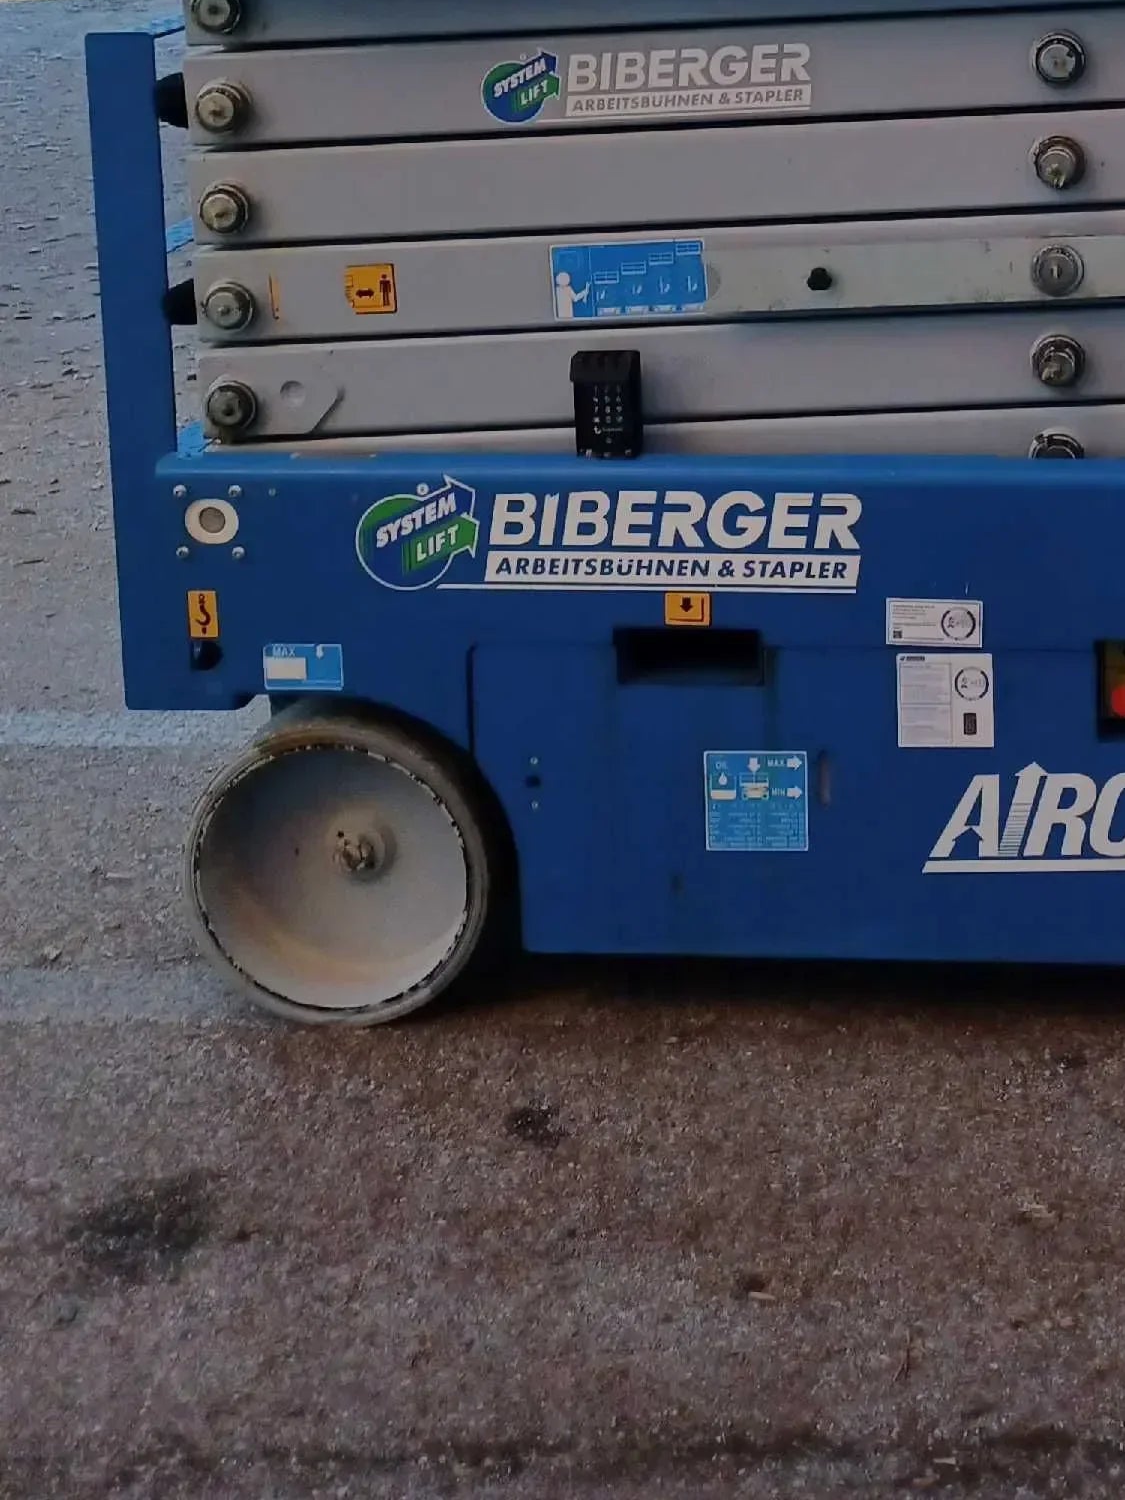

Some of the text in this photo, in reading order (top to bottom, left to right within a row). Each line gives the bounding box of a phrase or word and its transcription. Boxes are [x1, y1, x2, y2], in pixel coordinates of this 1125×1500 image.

[493, 57, 547, 98] SYSTEM
[567, 43, 811, 93] BIBERGER
[520, 79, 548, 106] LIFT
[719, 91, 730, 105] &
[735, 88, 804, 105] STAPLER
[376, 492, 457, 549] SYSTEM
[489, 490, 863, 550] BIBERGER
[416, 524, 459, 562] LIFT
[495, 557, 848, 580] ARBEITSBÜHNEN & STAPLER
[272, 644, 297, 658] MAX
